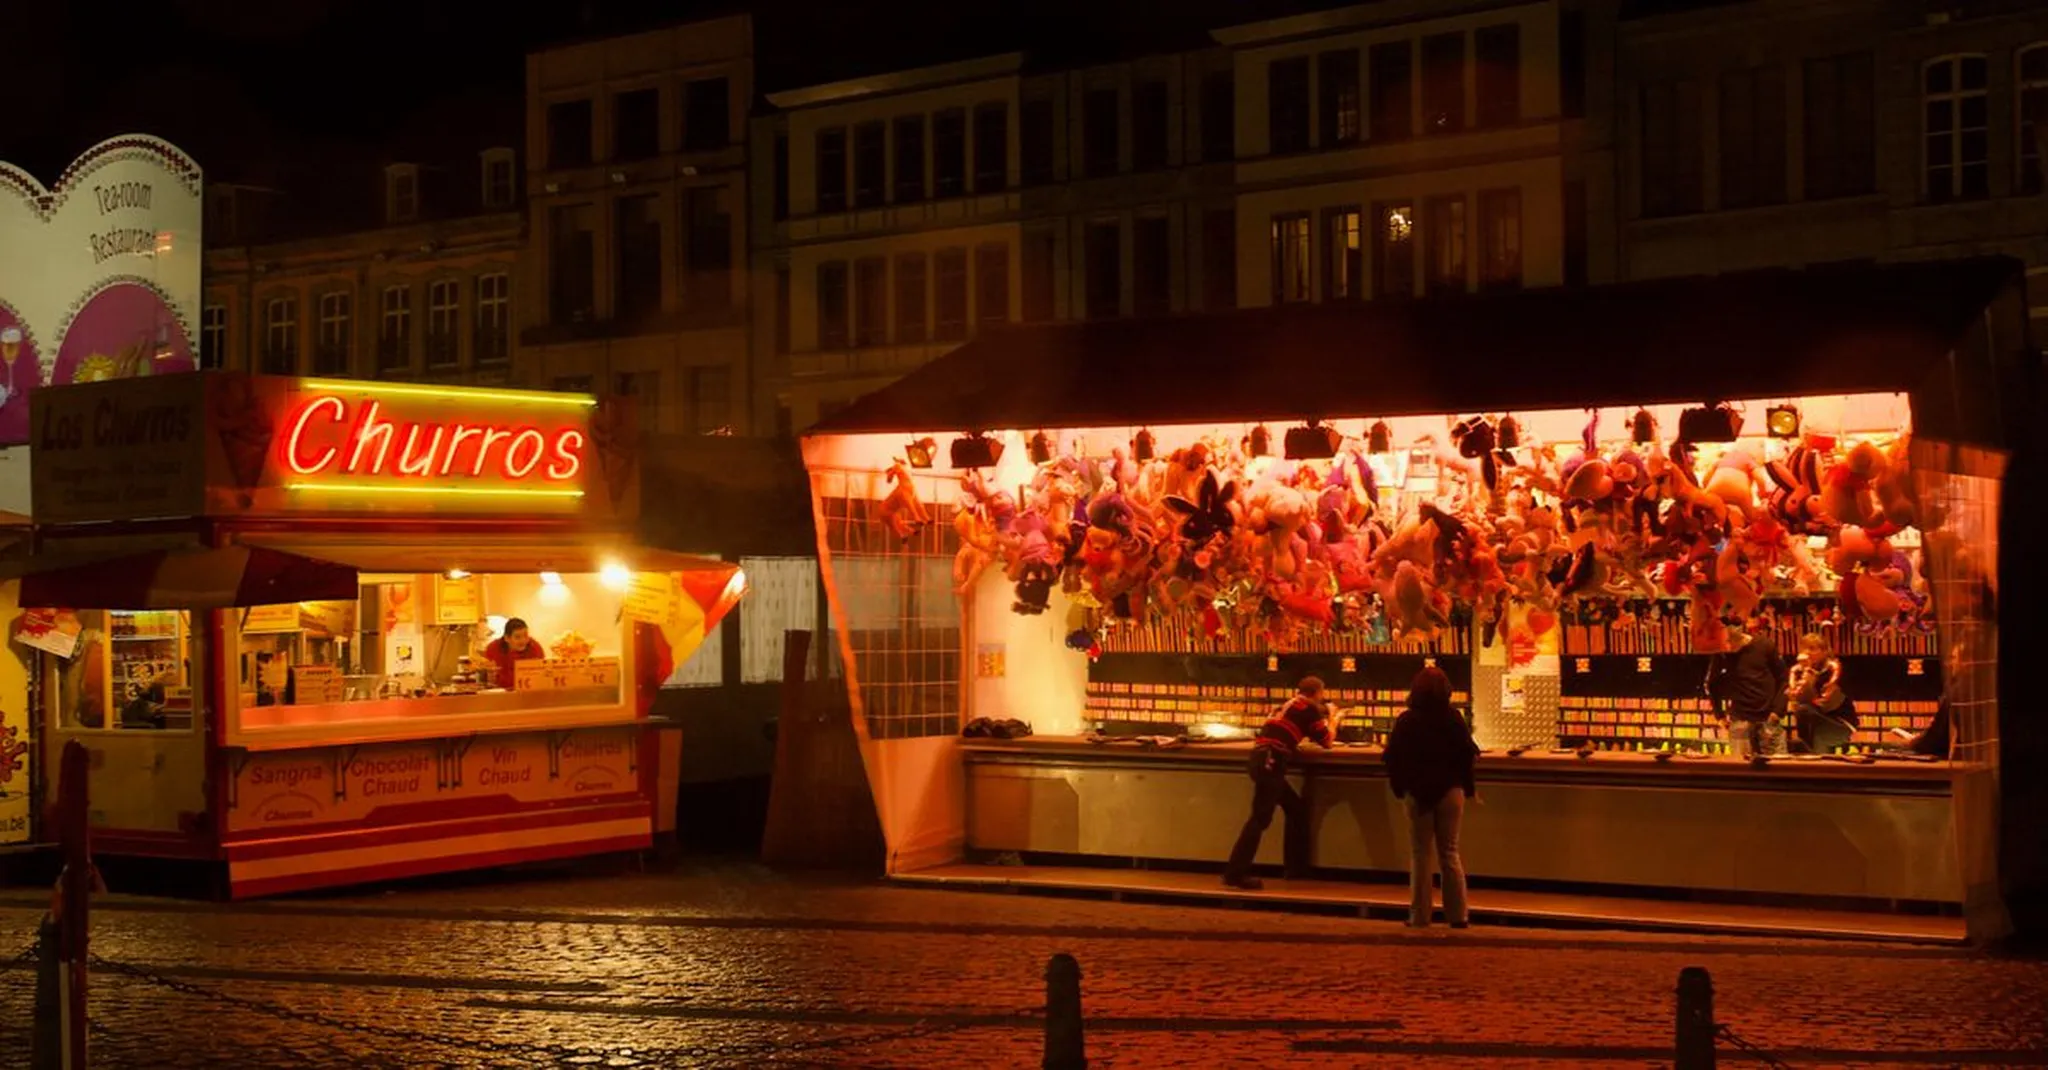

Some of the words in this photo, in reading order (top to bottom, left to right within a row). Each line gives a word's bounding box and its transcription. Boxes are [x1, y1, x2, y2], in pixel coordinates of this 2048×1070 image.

[41, 400, 85, 451] Los
[93, 396, 191, 447] Churros
[287, 396, 583, 480] Churros
[350, 754, 430, 778] Chocolat
[492, 746, 517, 765] Vin
[362, 776, 419, 797] Chaud
[480, 765, 532, 787] Chaud
